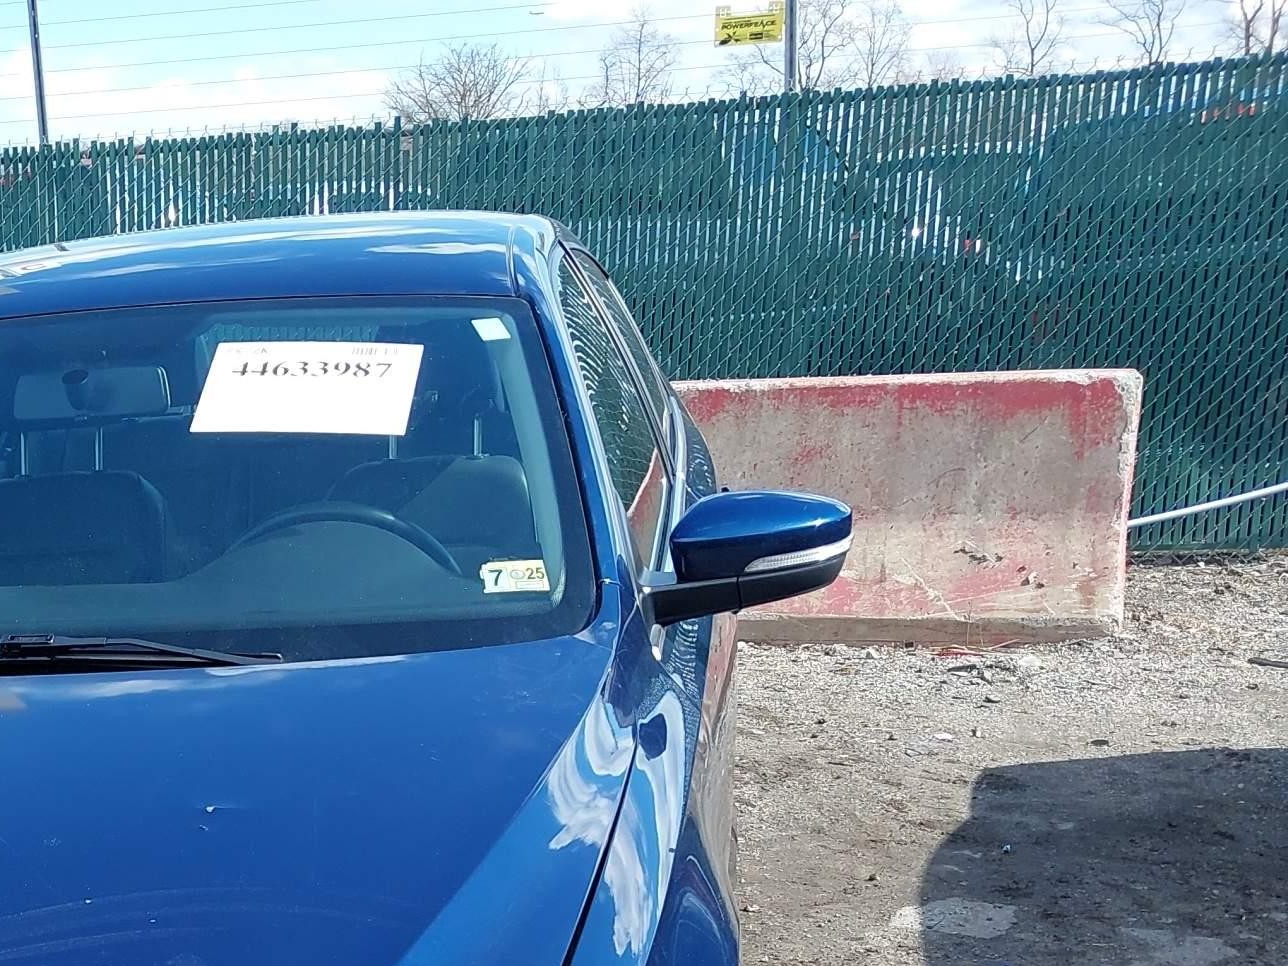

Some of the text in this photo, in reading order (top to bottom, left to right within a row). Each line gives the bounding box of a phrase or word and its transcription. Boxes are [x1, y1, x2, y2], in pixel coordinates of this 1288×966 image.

[231, 360, 393, 378] 44633987
[487, 568, 503, 587] 7
[526, 566, 545, 580] 25
